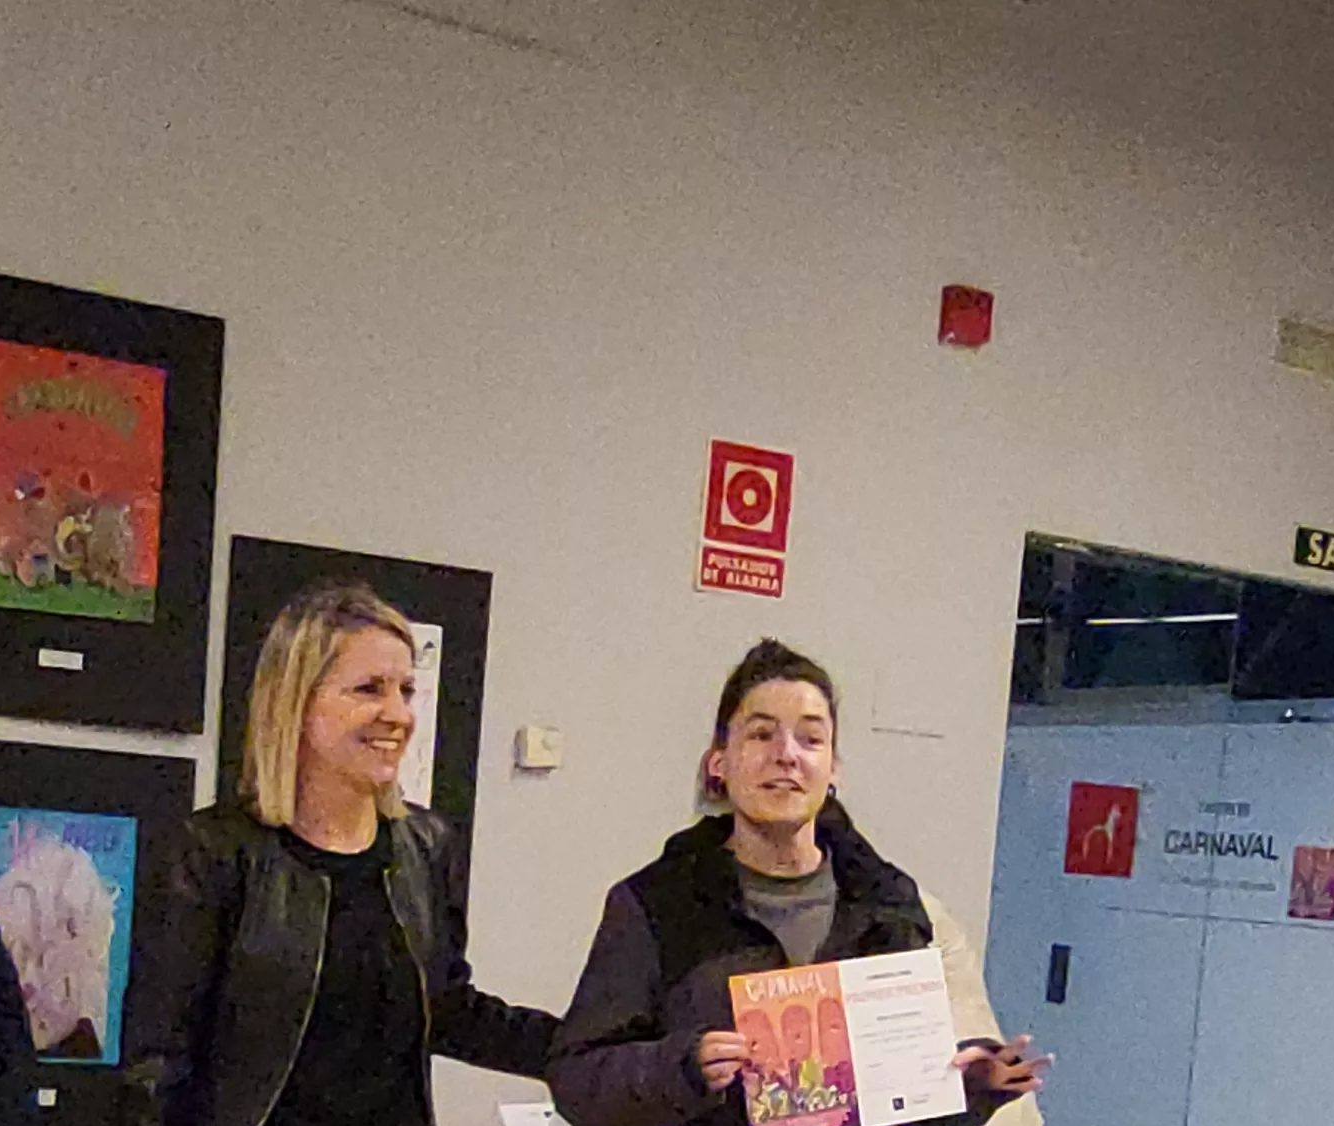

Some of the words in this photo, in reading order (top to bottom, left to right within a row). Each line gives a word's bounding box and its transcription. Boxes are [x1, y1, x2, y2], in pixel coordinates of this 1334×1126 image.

[703, 568, 719, 583] DE
[726, 571, 779, 592] ALARMA
[1164, 830, 1279, 861] CARNAVAL
